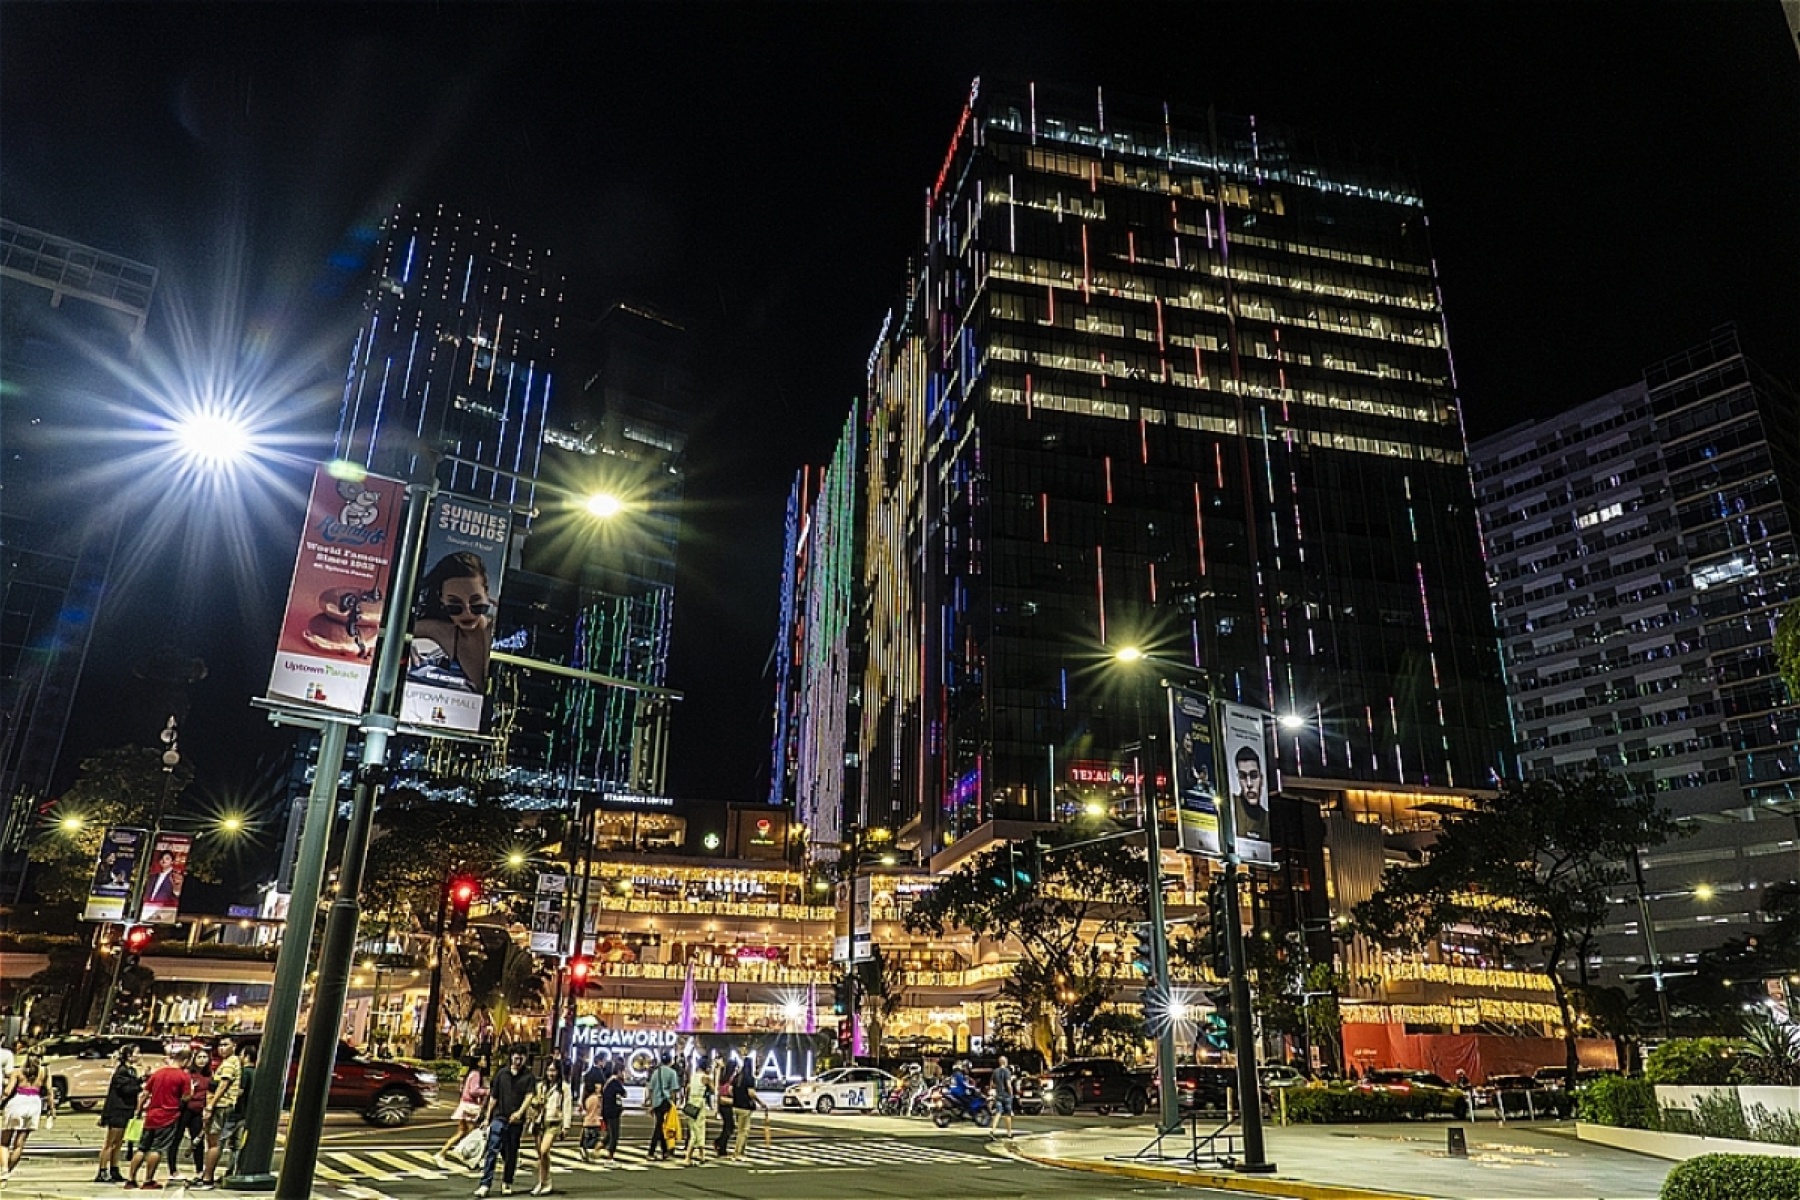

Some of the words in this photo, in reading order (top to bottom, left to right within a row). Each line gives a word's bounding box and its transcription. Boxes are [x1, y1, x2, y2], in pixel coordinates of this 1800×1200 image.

[441, 502, 507, 531] SUNNIES
[438, 516, 506, 543] STUDIOS
[306, 541, 342, 556] World
[343, 549, 388, 566] Famous
[316, 553, 348, 566] Since
[406, 688, 449, 705] UPTOWN
[450, 697, 478, 710] MALL
[573, 1025, 677, 1046] MEGAWORLD
[729, 1049, 818, 1081] MALL
